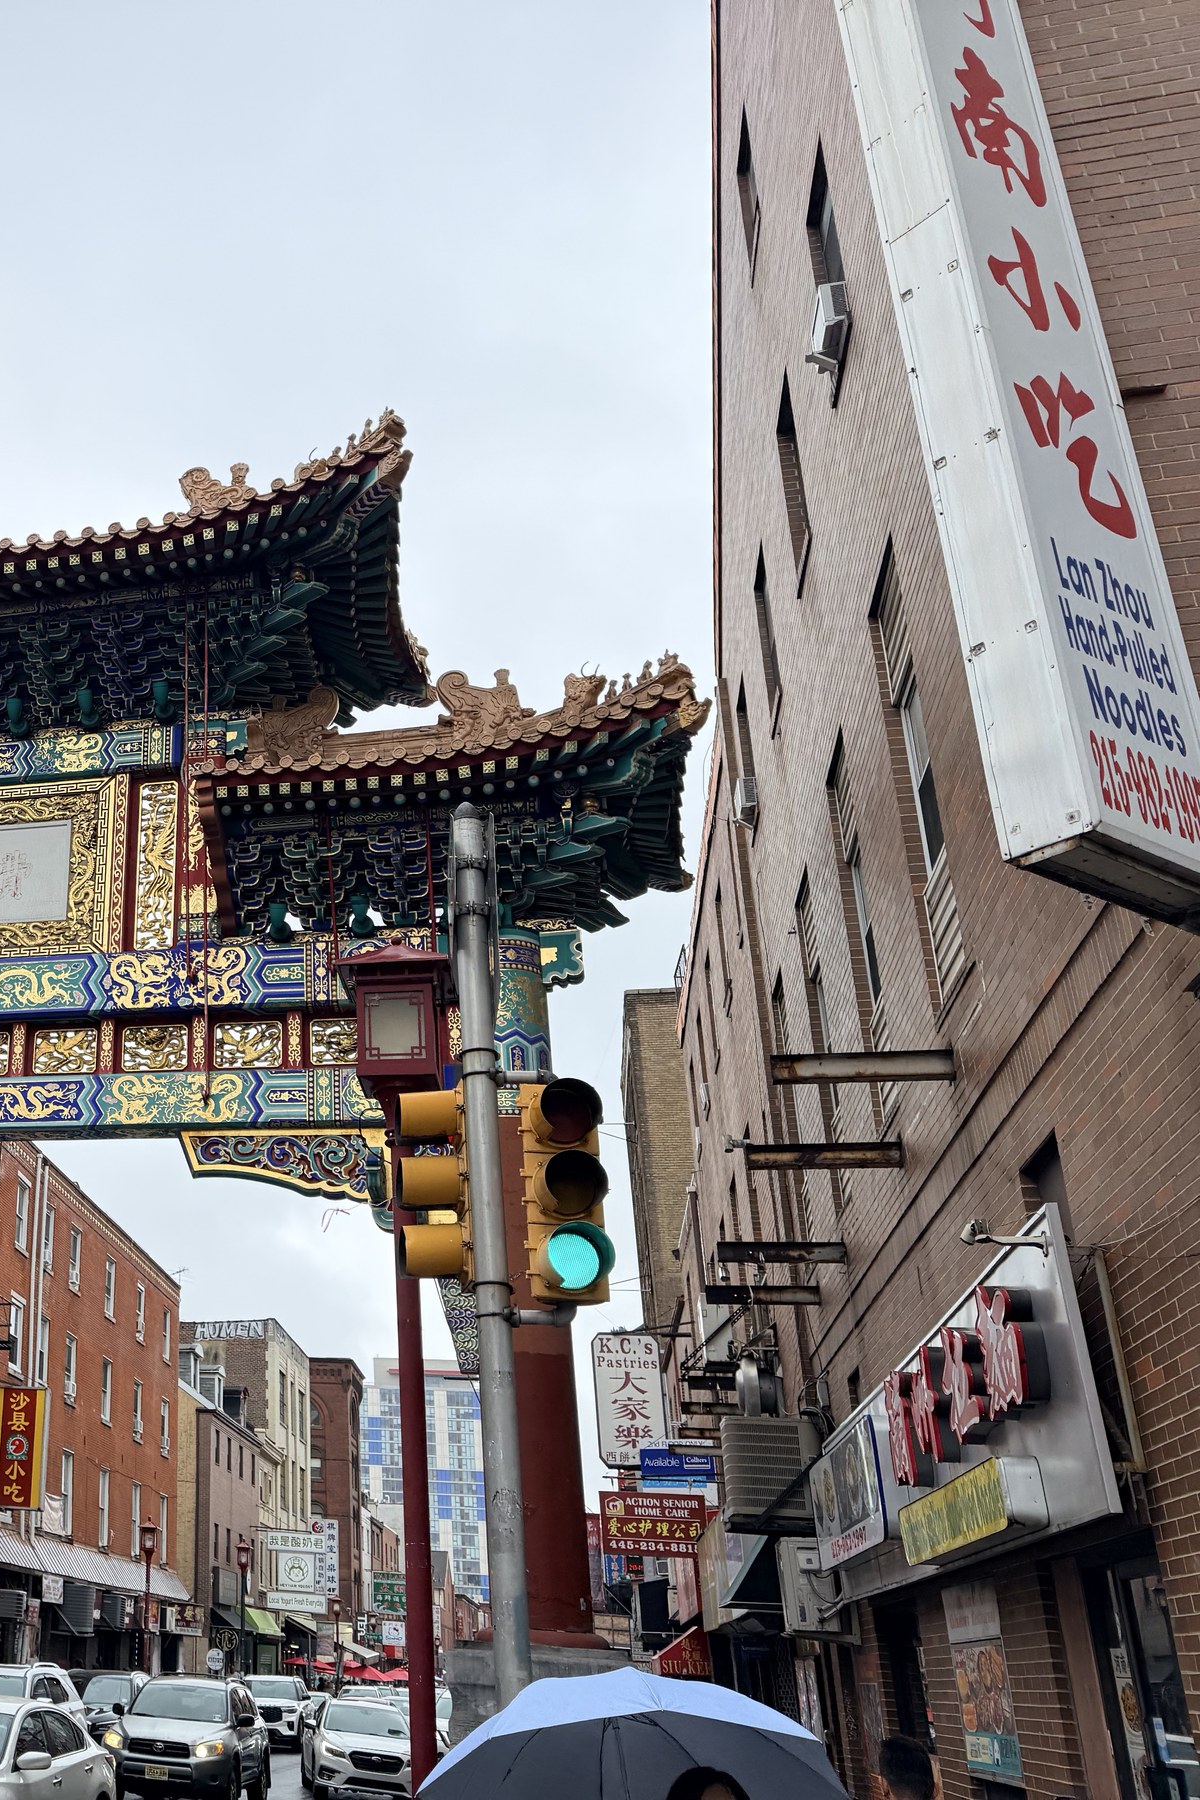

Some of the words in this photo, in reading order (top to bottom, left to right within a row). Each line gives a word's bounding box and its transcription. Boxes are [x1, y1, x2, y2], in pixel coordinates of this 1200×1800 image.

[1050, 536, 1099, 604] Lan
[1094, 557, 1156, 632] Zhou
[1058, 595, 1178, 696] Hand-Pulled
[1082, 664, 1187, 758] Noodles
[194, 1321, 265, 1341] HUMEN
[598, 1337, 653, 1355] K.C.'s
[596, 1356, 658, 1369] Pastries
[609, 1371, 654, 1449] 大家樂
[644, 1457, 680, 1468] Available
[625, 1497, 660, 1508] ACTION
[662, 1498, 699, 1509] SENIOR
[634, 1507, 662, 1517] HOME
[665, 1508, 691, 1518] CARE
[607, 1518, 701, 1538] 爱心护理公司
[662, 1660, 681, 1675] SIU
